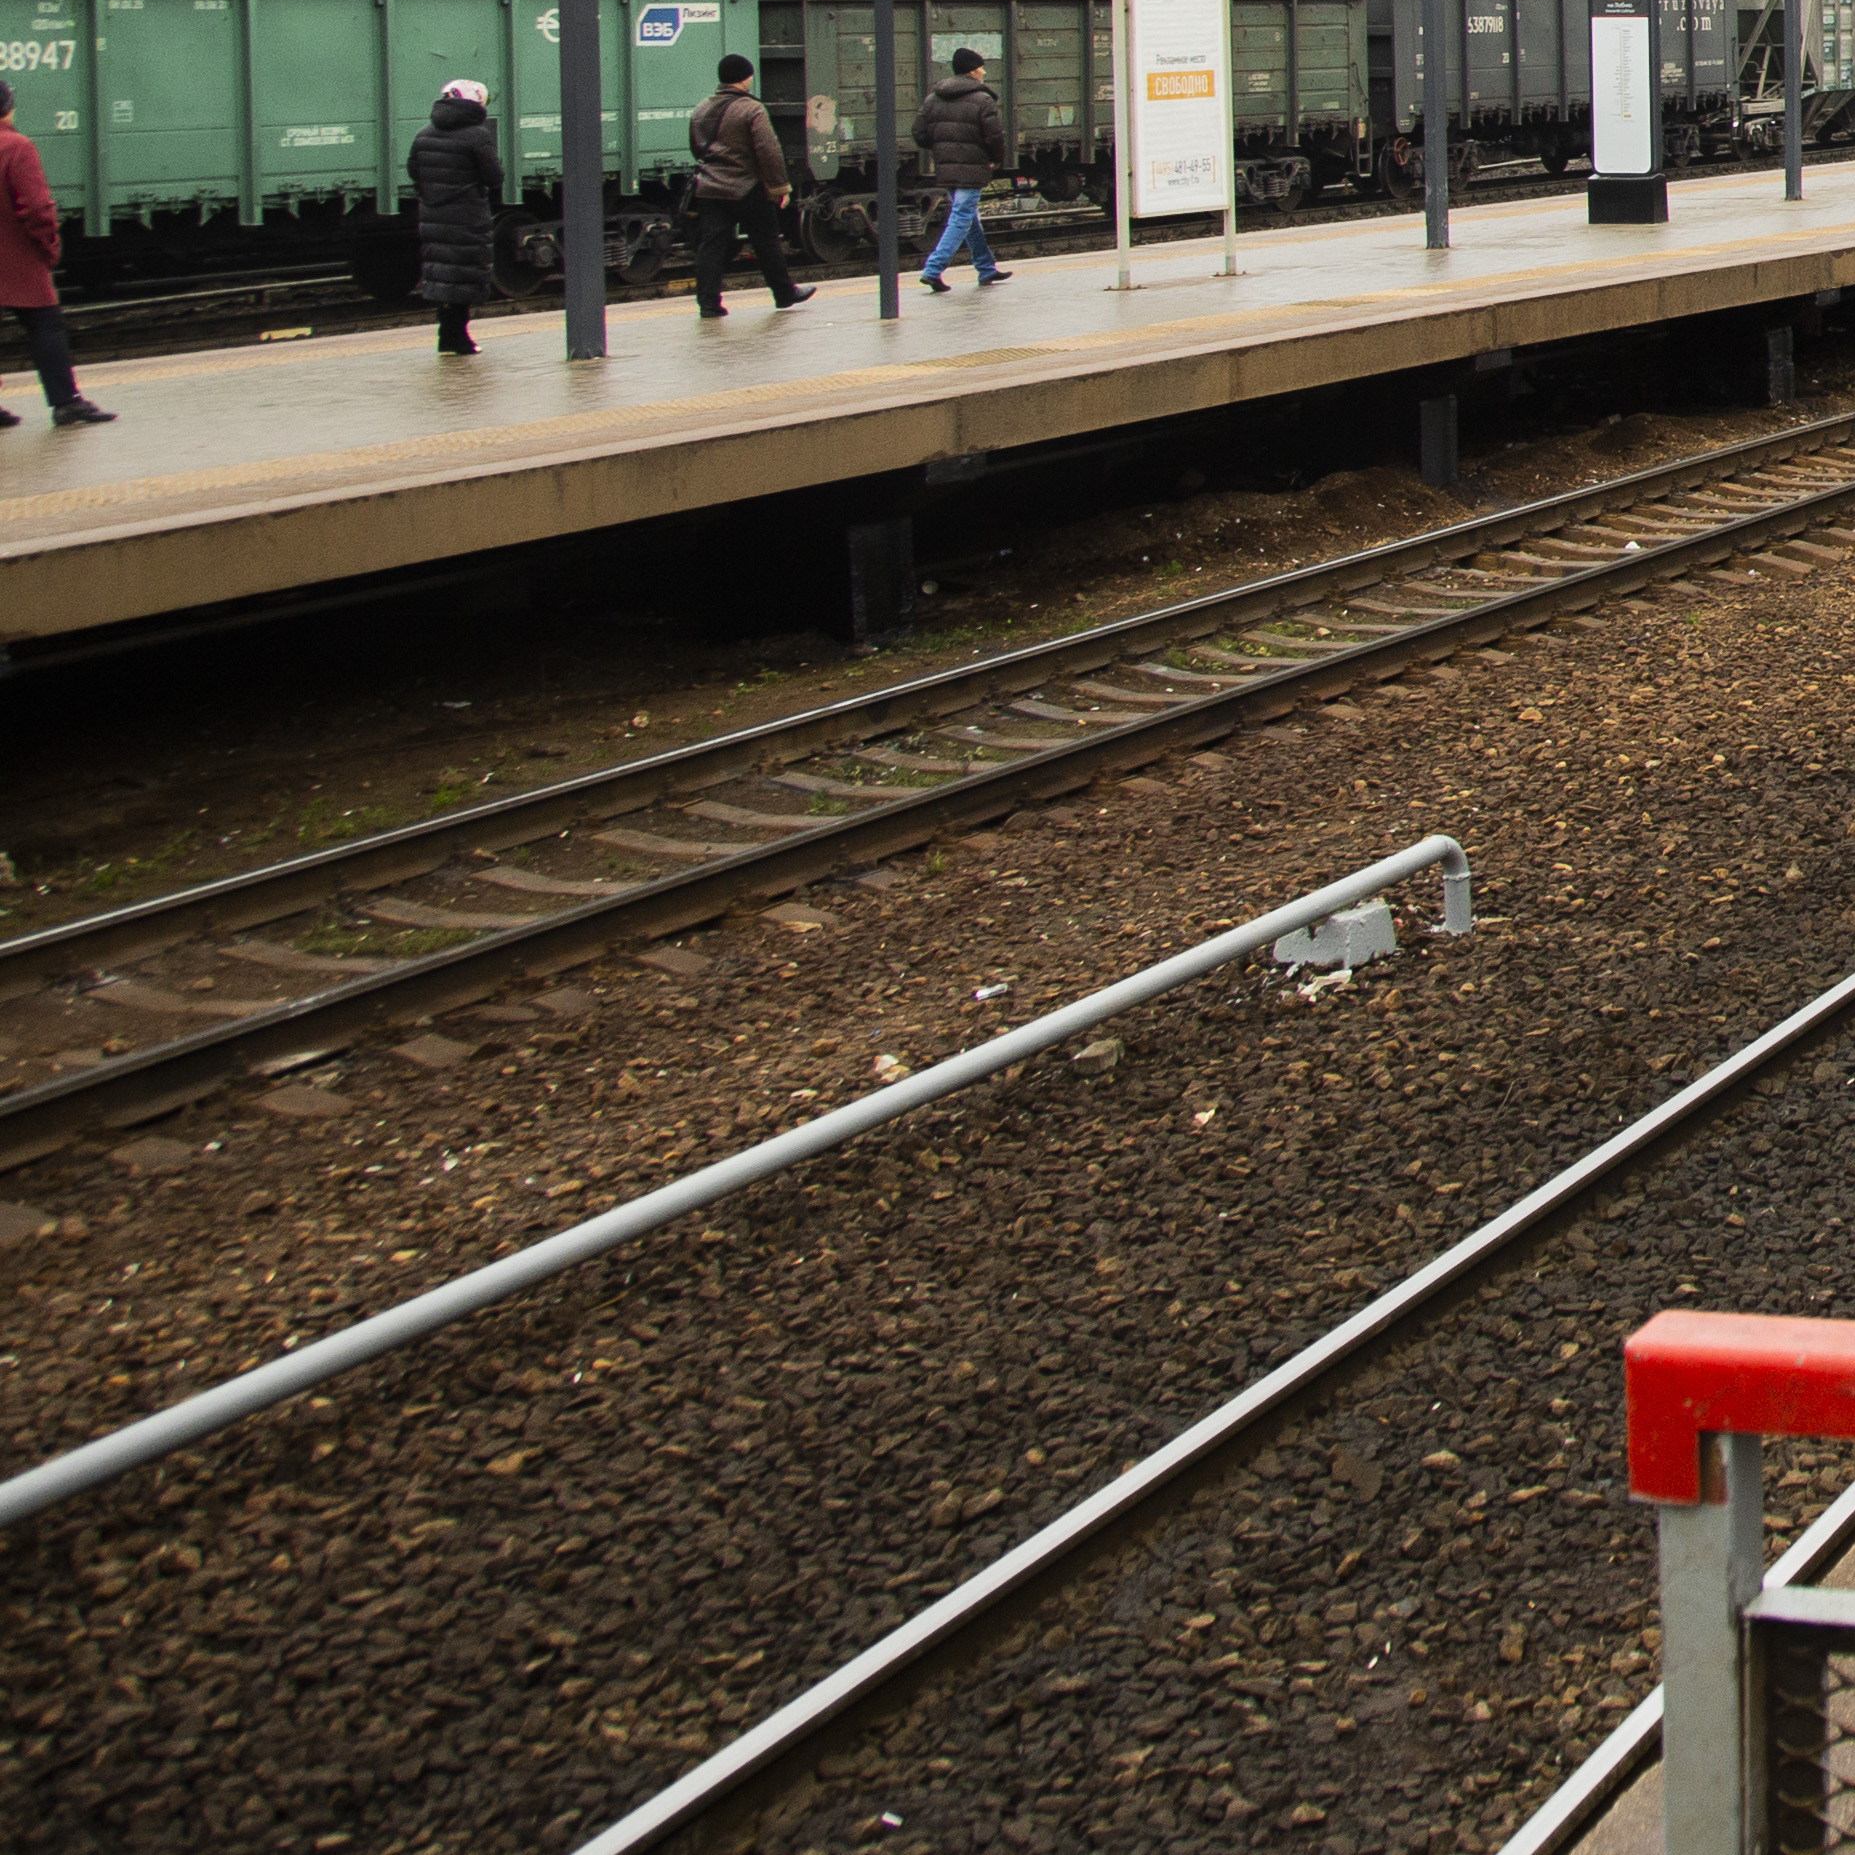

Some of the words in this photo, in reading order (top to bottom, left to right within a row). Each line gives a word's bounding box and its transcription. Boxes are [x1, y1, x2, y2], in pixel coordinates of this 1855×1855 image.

[682, 7, 717, 19] Лизинг
[641, 21, 674, 37] ВЭБ
[1155, 74, 1209, 96] СВОБОДНО
[55, 110, 79, 130] 20
